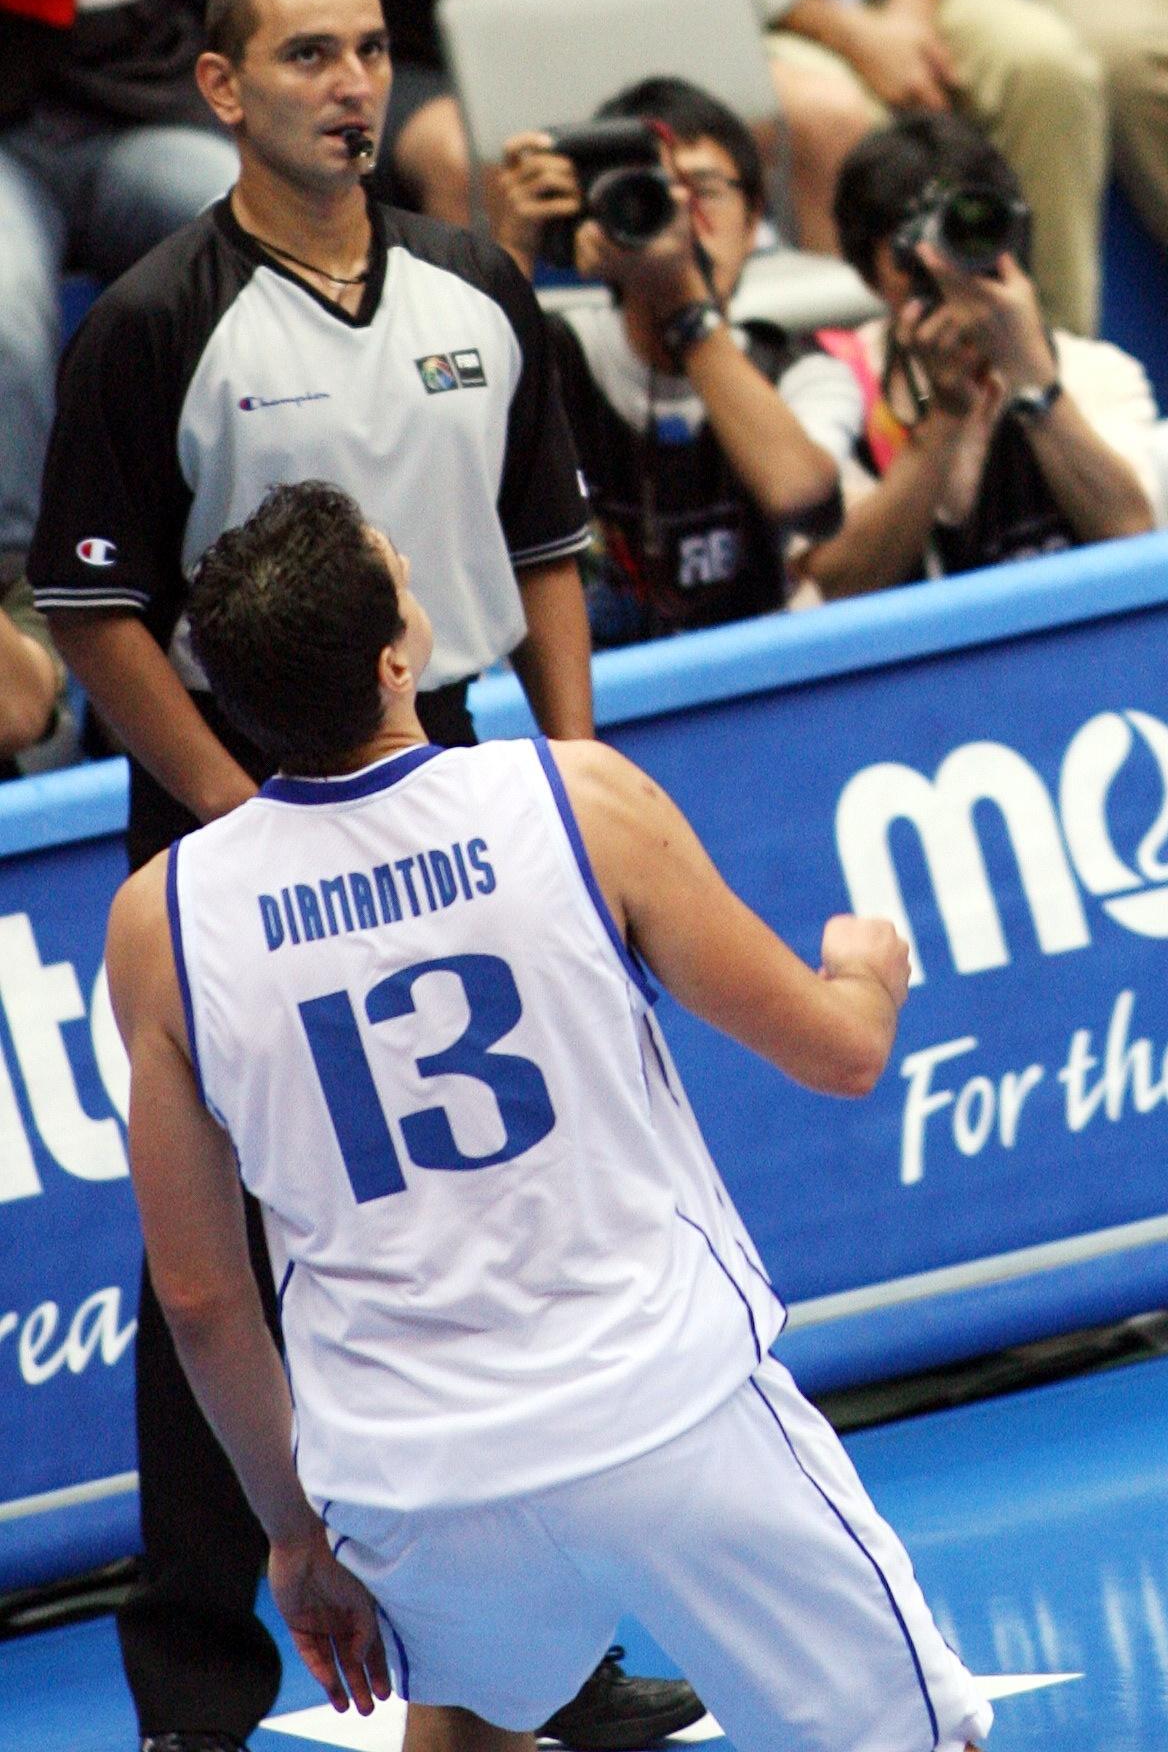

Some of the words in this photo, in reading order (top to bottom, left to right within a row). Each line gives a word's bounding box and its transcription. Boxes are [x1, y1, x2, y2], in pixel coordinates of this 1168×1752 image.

[258, 837, 496, 952] DIAMANTIDIS
[298, 953, 556, 1205] 13
[900, 1035, 1044, 1186] For
